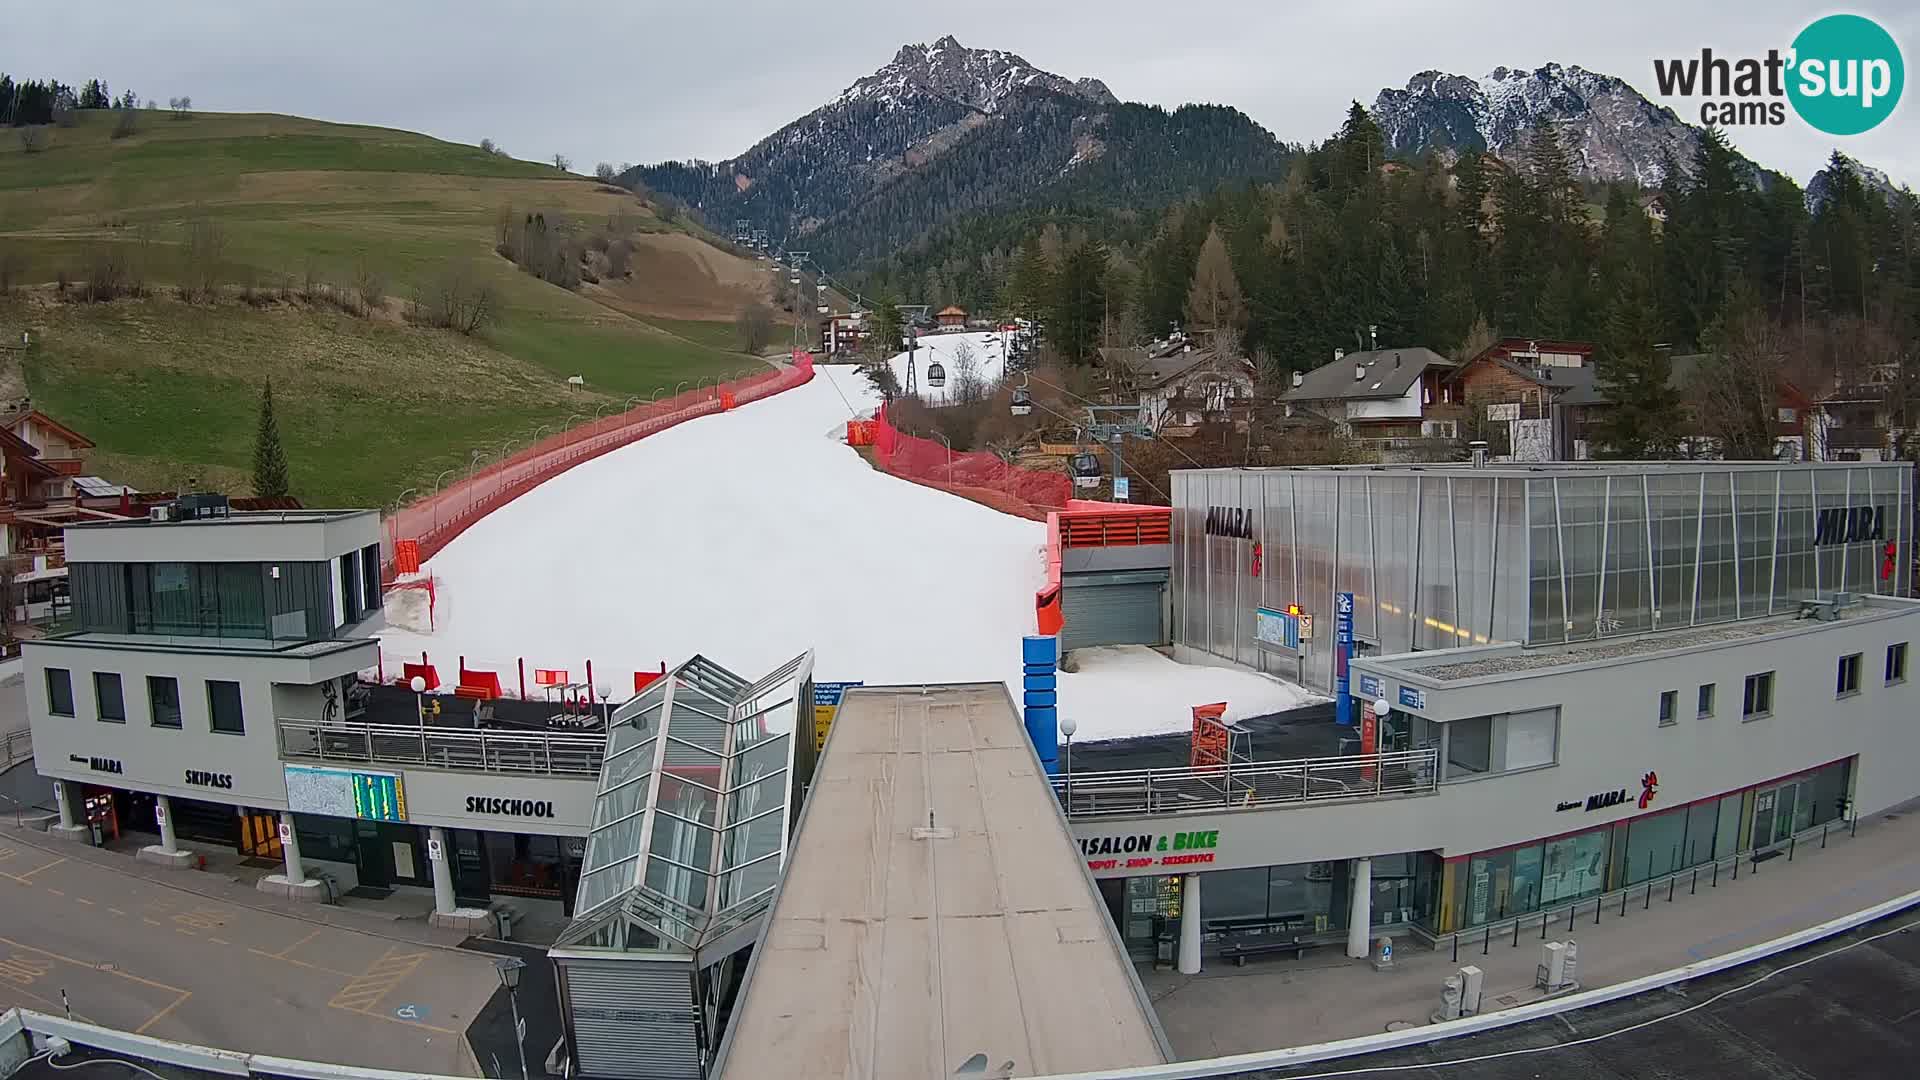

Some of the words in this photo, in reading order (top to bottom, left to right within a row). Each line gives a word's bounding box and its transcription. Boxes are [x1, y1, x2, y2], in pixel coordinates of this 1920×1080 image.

[1206, 505, 1253, 540] MIARA
[1813, 505, 1885, 546] MIARA
[90, 757, 123, 775] MIARA
[185, 769, 233, 790] SKIPASS
[466, 795, 555, 818] SKISCHOOL
[1585, 789, 1626, 812] MIARA
[1156, 836, 1169, 852] &
[1173, 830, 1219, 851] BIKE
[1126, 857, 1152, 868] SHOP
[1161, 853, 1215, 865] SKISERVICE
